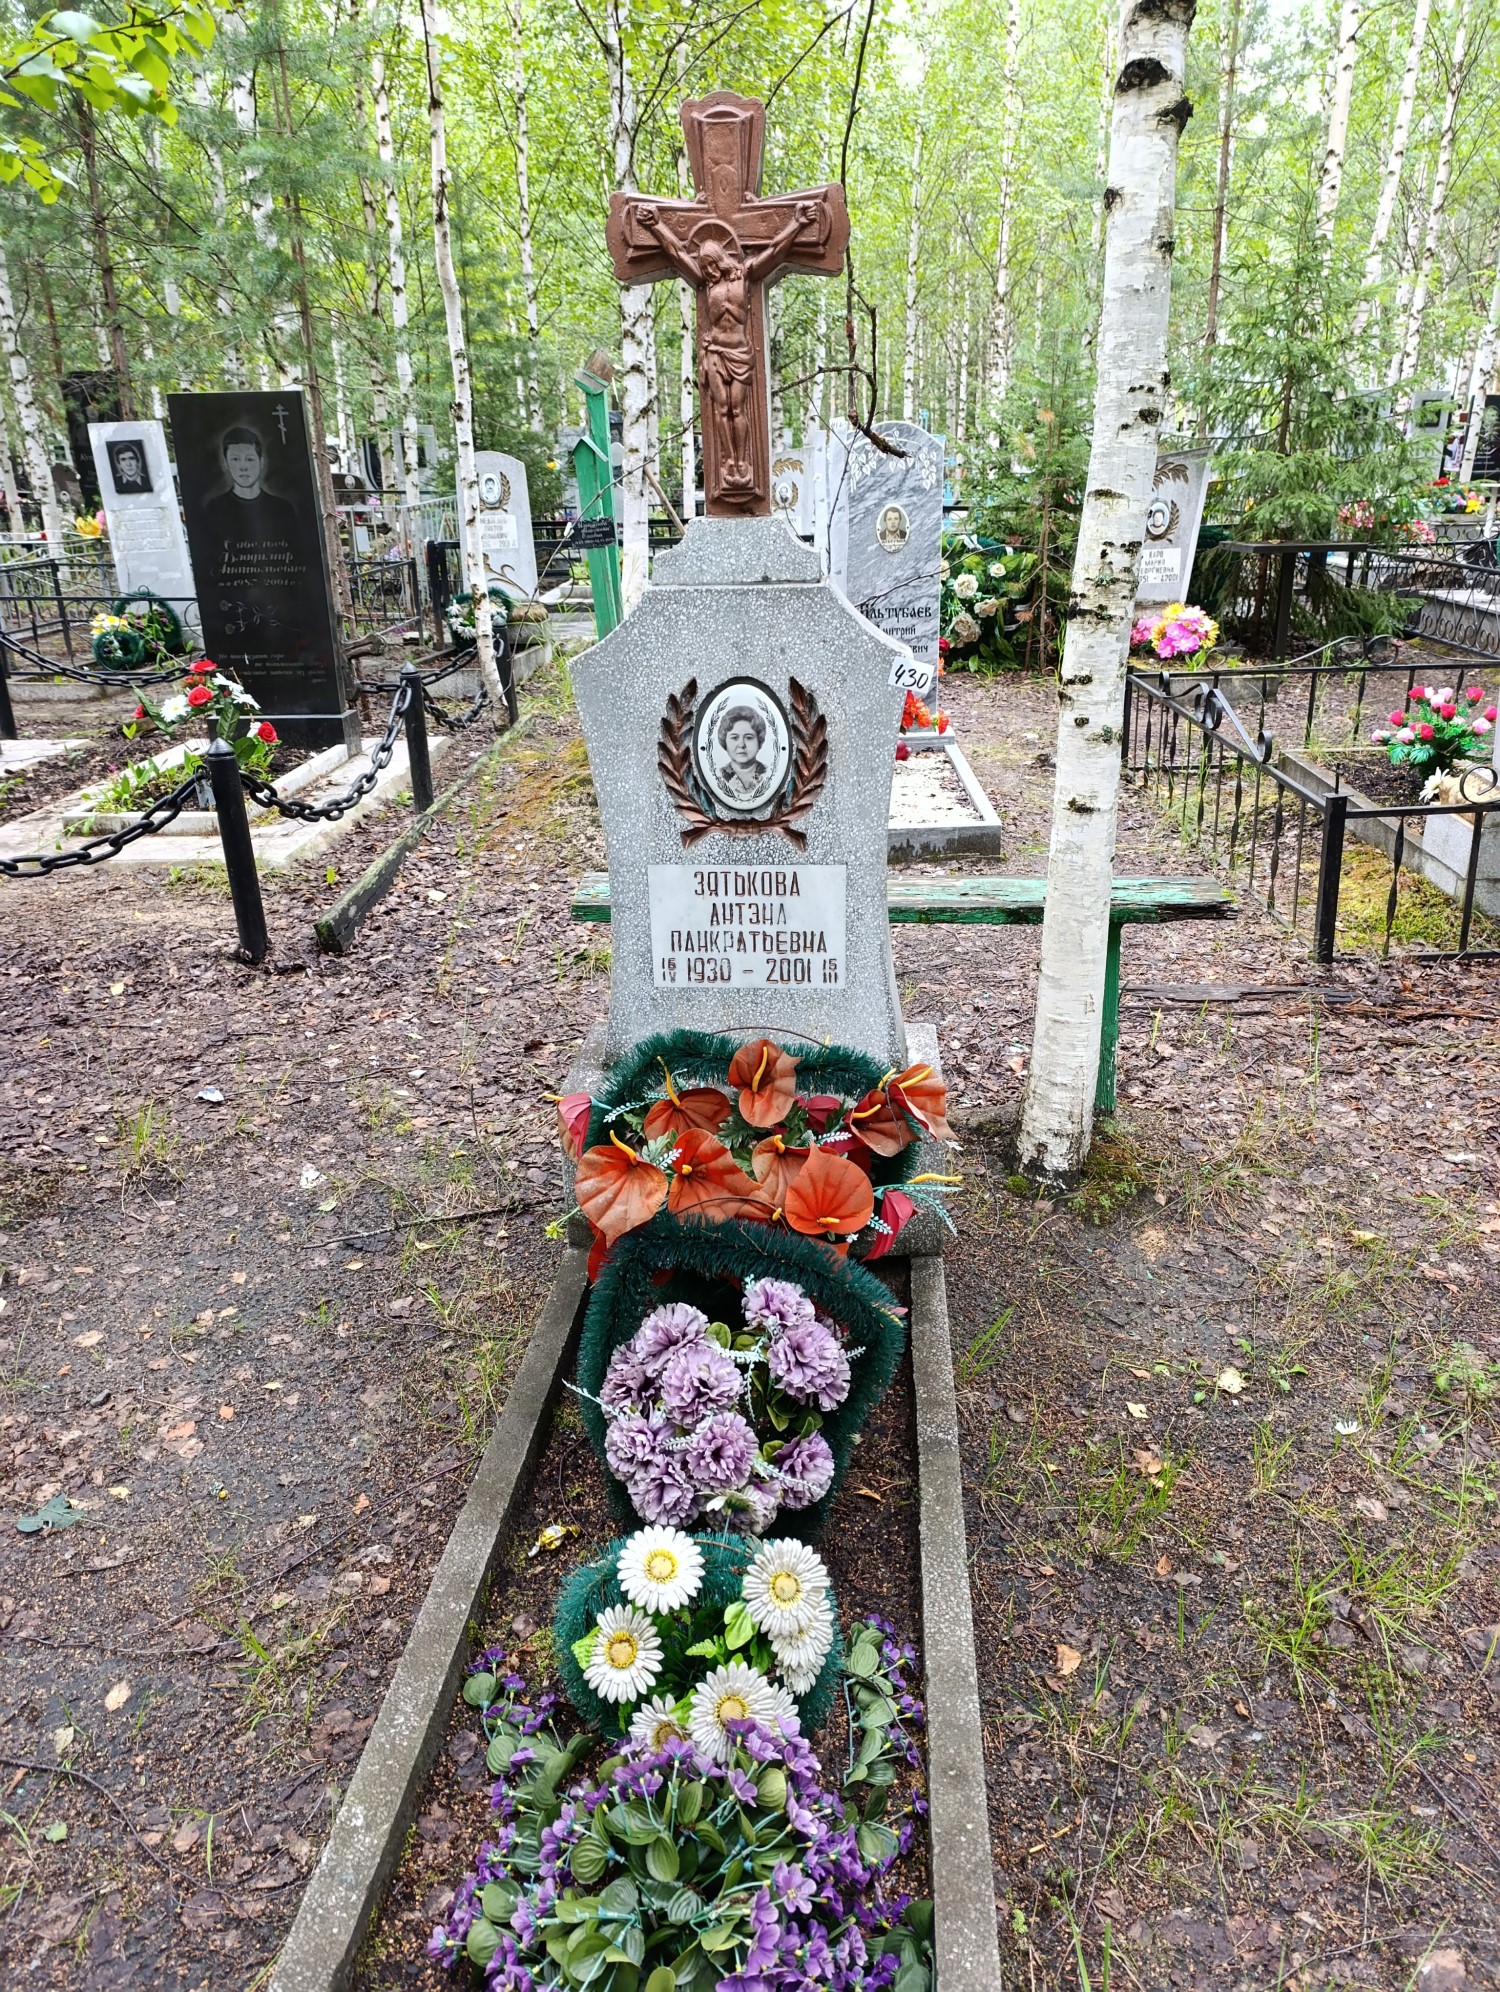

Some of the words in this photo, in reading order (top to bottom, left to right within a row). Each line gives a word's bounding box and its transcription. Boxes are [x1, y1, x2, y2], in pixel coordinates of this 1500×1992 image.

[1140, 566, 1175, 575] ЕОРГИЕВНА
[894, 663, 929, 689] 430
[693, 871, 801, 897] ЗЯТЬКОВА
[671, 930, 828, 954] ПАНКРАТЬЕВНА
[687, 957, 732, 983] 1930
[766, 957, 812, 984] 2001
